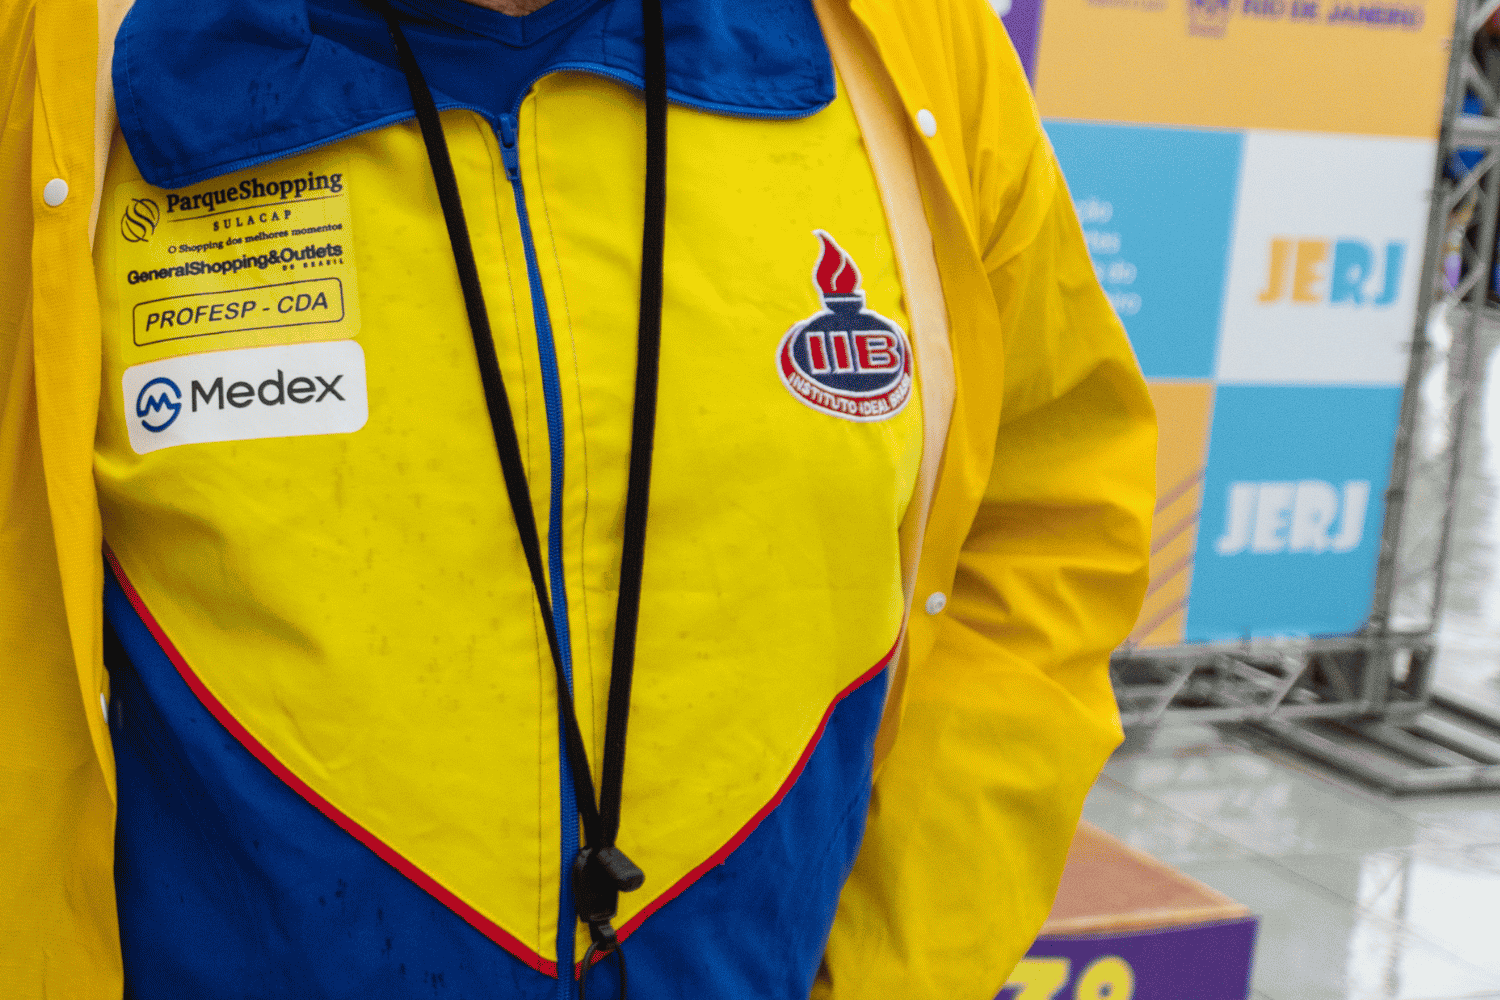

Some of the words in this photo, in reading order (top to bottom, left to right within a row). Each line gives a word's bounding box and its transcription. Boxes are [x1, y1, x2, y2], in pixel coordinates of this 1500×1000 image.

[167, 172, 344, 213] ParqueShopping
[168, 245, 176, 254] O
[179, 241, 224, 254] Shopping
[226, 236, 243, 247] dos
[245, 229, 288, 244] melhores
[291, 222, 343, 237] momentos
[213, 209, 292, 232] SULACAP
[127, 243, 344, 286] GeneralShopping&Outlets
[1256, 234, 1407, 308] JERJ
[146, 299, 257, 332] PROFESP
[277, 292, 328, 315] CDA
[805, 330, 901, 375] IIB
[191, 369, 347, 413] Medex
[787, 372, 857, 415] INSTITUTO
[1216, 479, 1371, 555] JERJ
